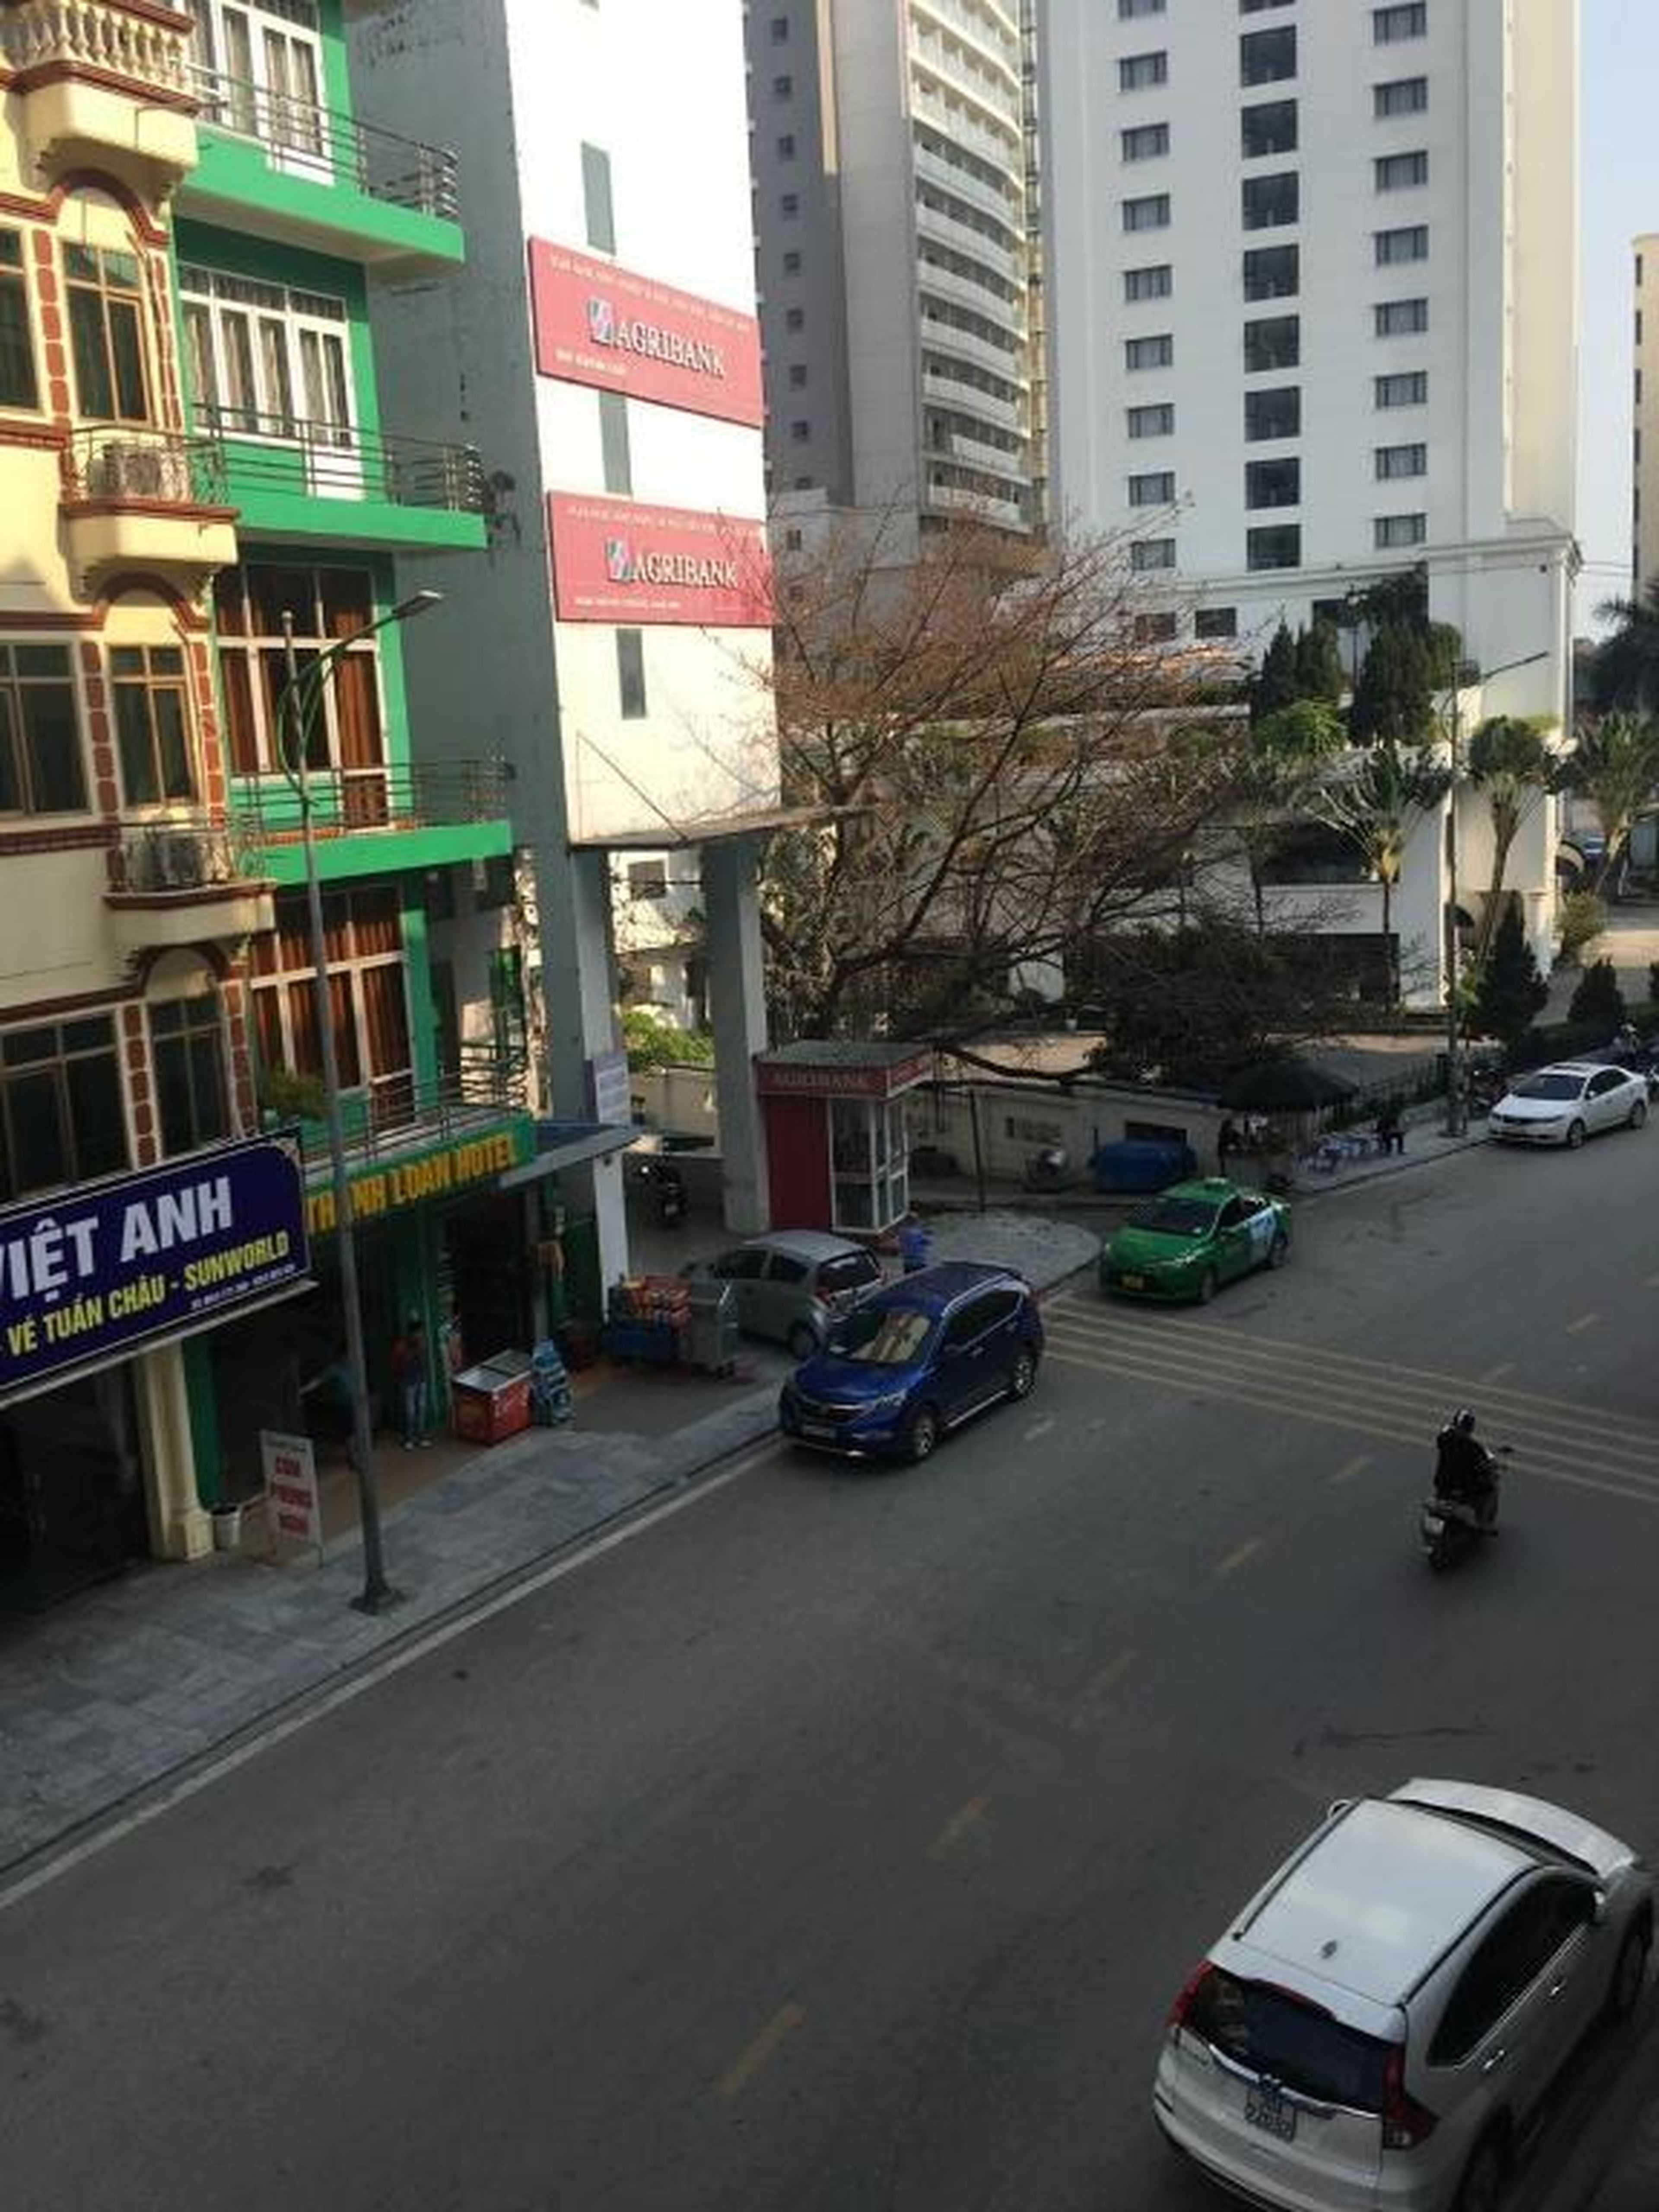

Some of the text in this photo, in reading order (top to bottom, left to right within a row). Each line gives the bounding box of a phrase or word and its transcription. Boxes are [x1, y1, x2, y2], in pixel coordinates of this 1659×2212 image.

[616, 321, 725, 378] AGRIBANK
[635, 553, 738, 588] AGRIBANK
[457, 1133, 516, 1182] HOTEL
[0, 1216, 99, 1302] IỆT
[120, 1176, 232, 1262] ANH
[108, 1275, 165, 1319] CHÂU
[184, 1230, 290, 1290] SUNWORLD
